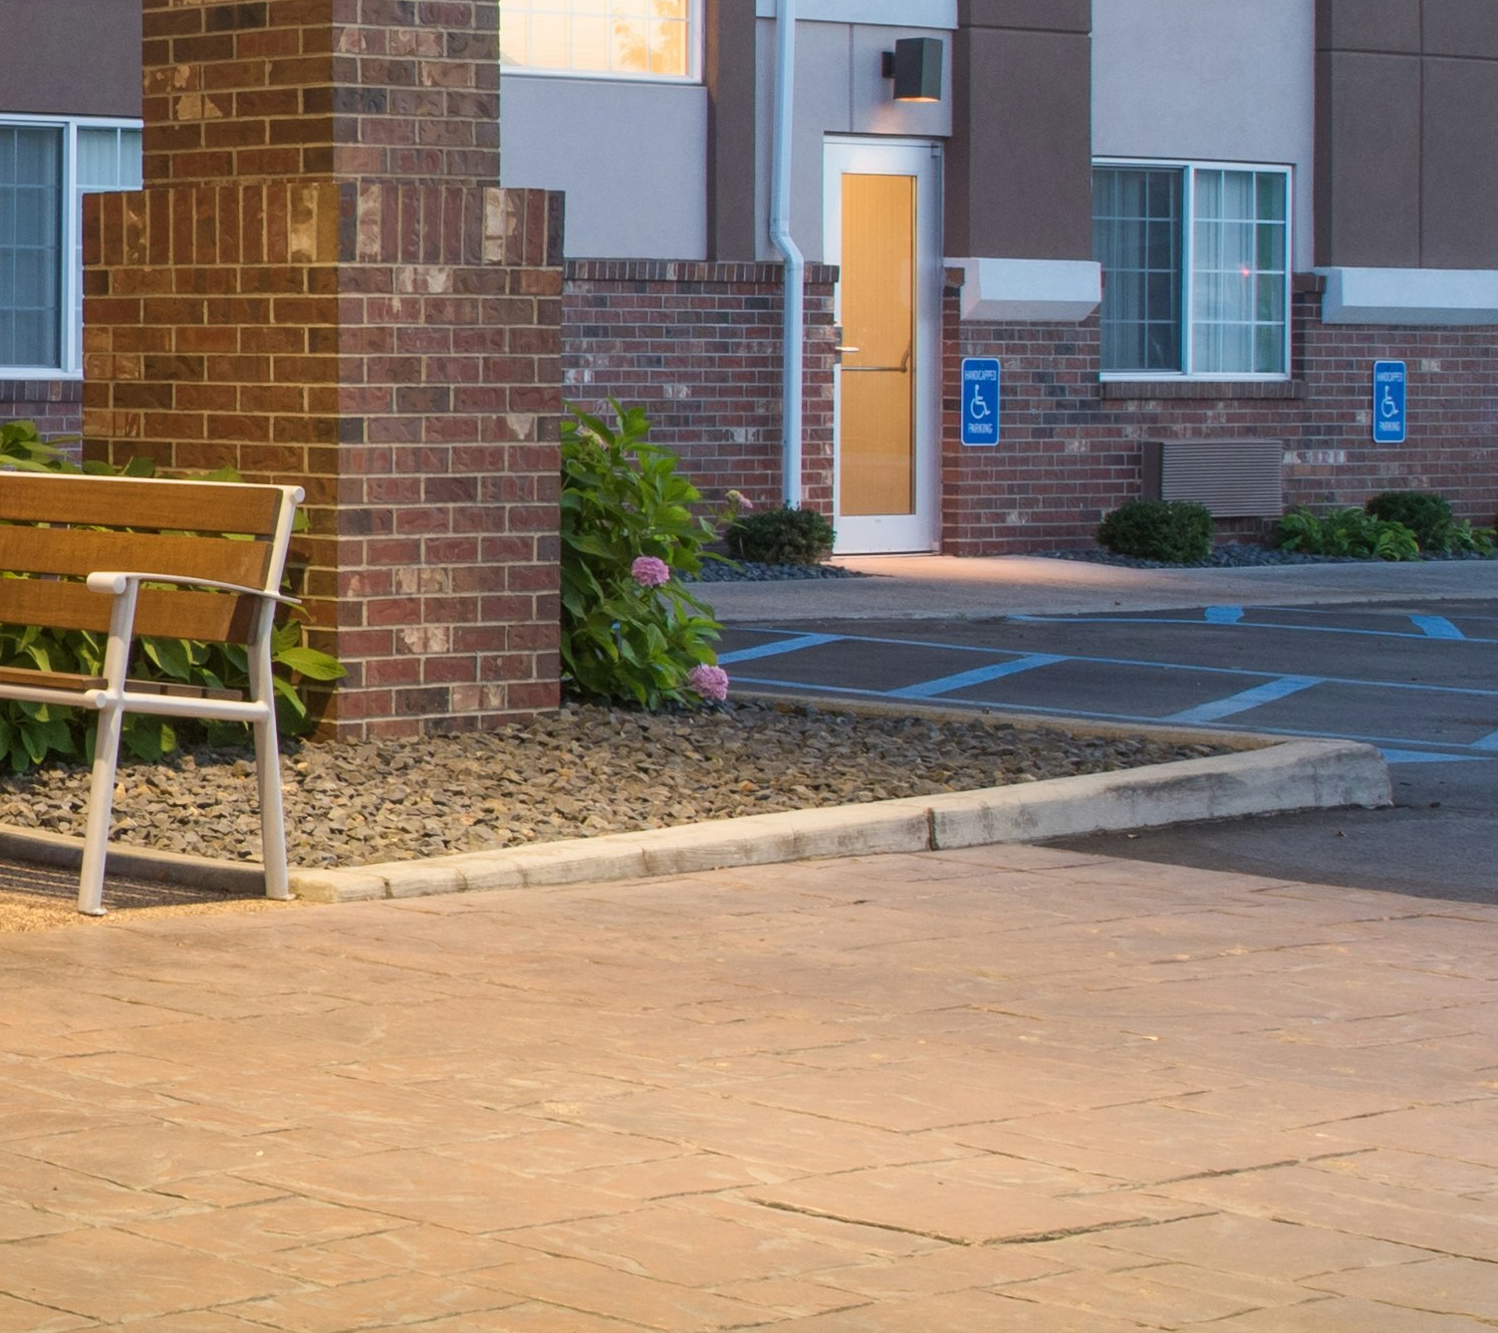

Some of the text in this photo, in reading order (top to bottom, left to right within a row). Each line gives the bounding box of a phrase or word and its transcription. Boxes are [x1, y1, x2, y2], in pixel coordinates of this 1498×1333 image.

[964, 370, 997, 381] HANDICAPPED
[968, 423, 993, 434] PARKING
[1379, 421, 1401, 432] PARKING
